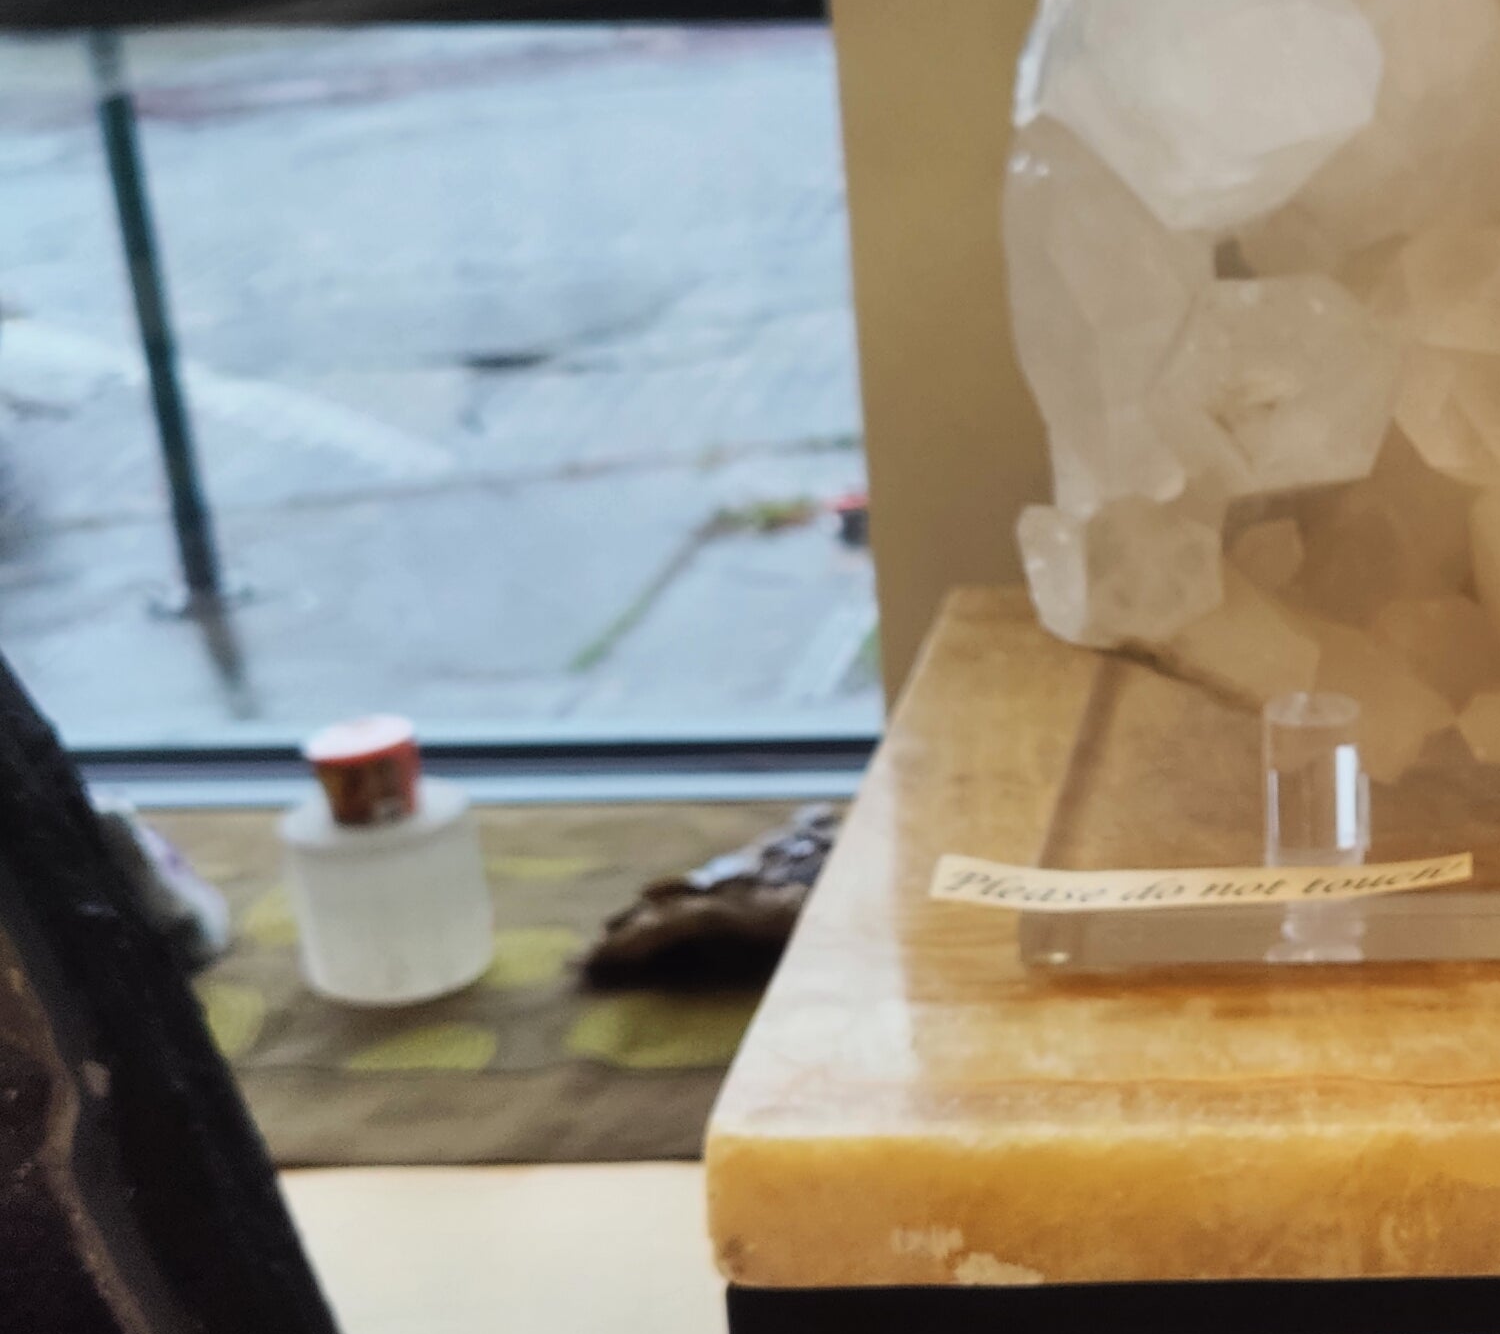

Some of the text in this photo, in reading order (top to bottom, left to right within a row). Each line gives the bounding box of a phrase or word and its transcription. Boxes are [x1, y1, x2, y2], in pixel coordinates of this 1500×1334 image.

[943, 870, 1108, 902] Please
[1120, 876, 1186, 902] do
[1199, 878, 1287, 897] not
